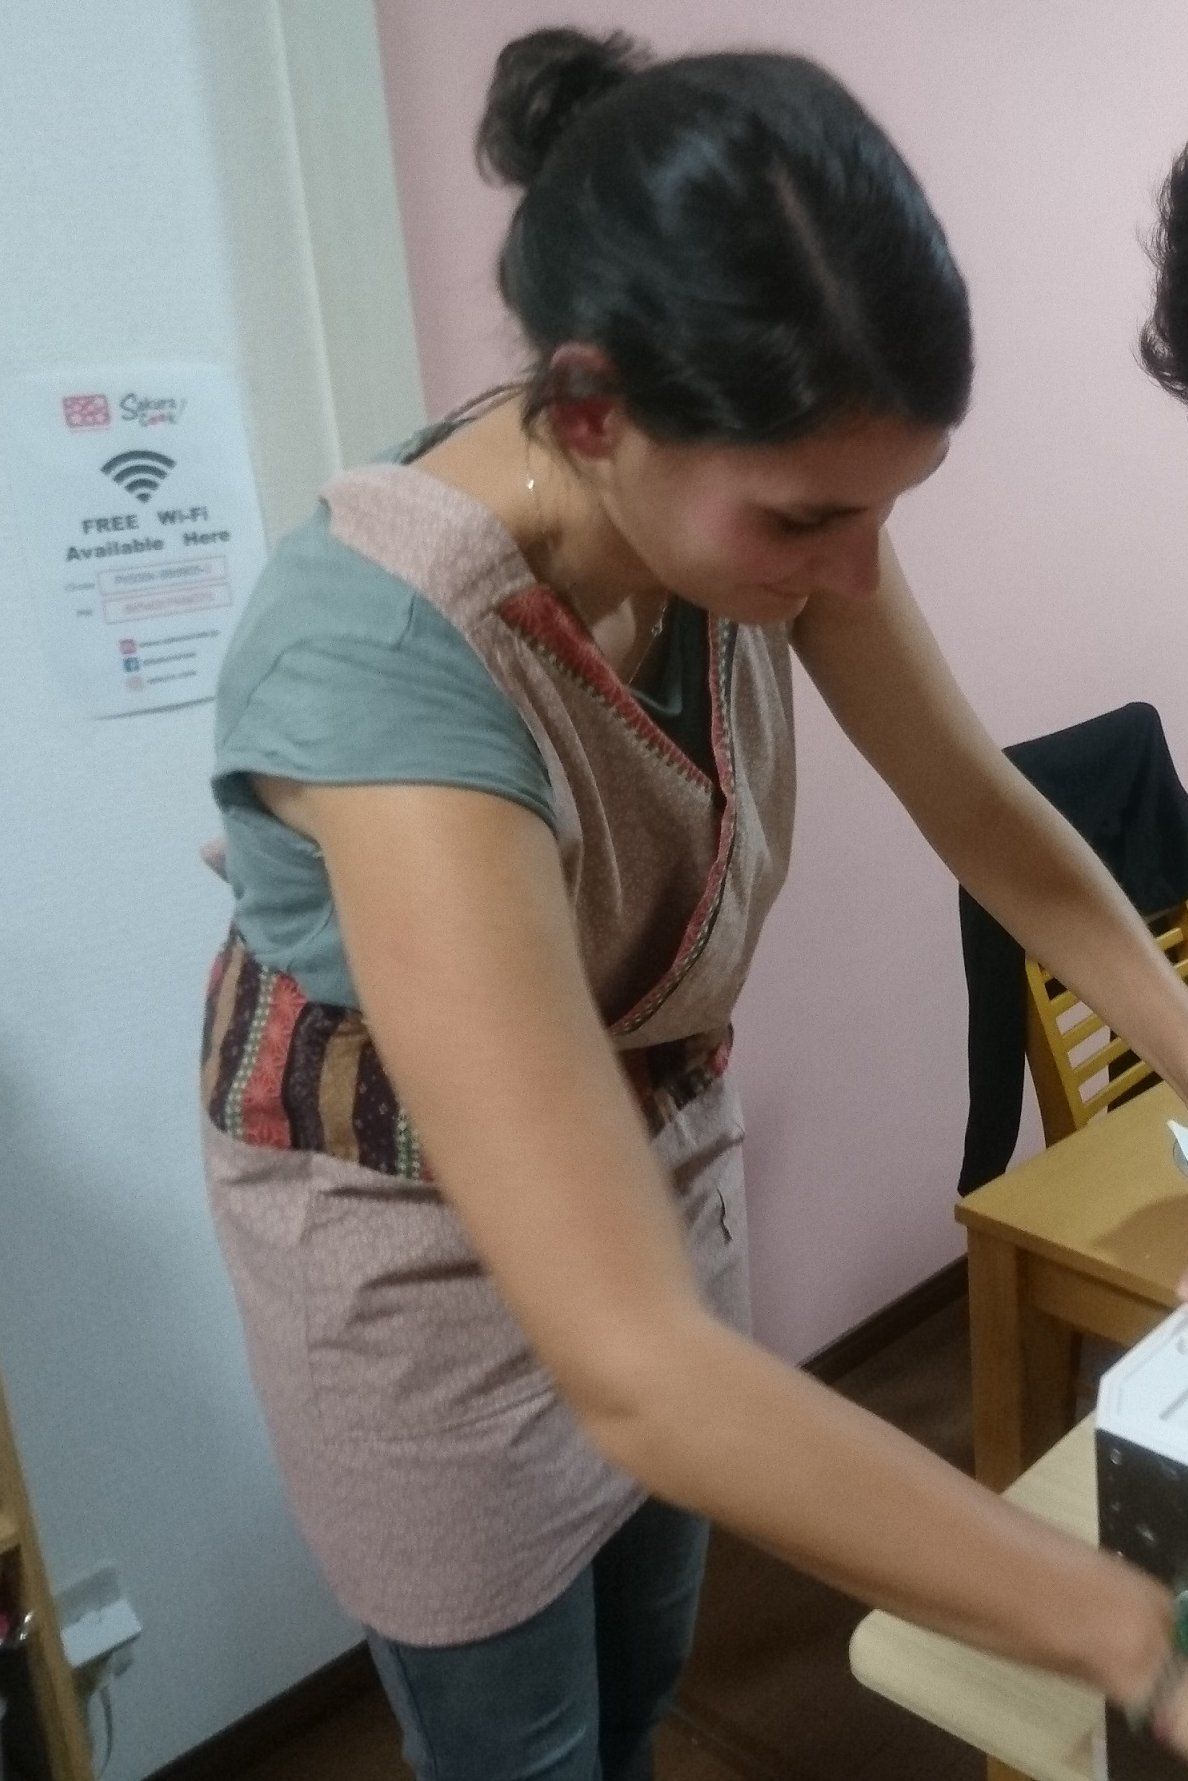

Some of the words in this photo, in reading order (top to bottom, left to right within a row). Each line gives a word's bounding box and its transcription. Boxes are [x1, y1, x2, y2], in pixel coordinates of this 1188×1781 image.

[82, 514, 139, 534] FREE
[157, 506, 208, 525] Wi-Fi
[66, 537, 164, 561] Available
[183, 530, 231, 546] Here
